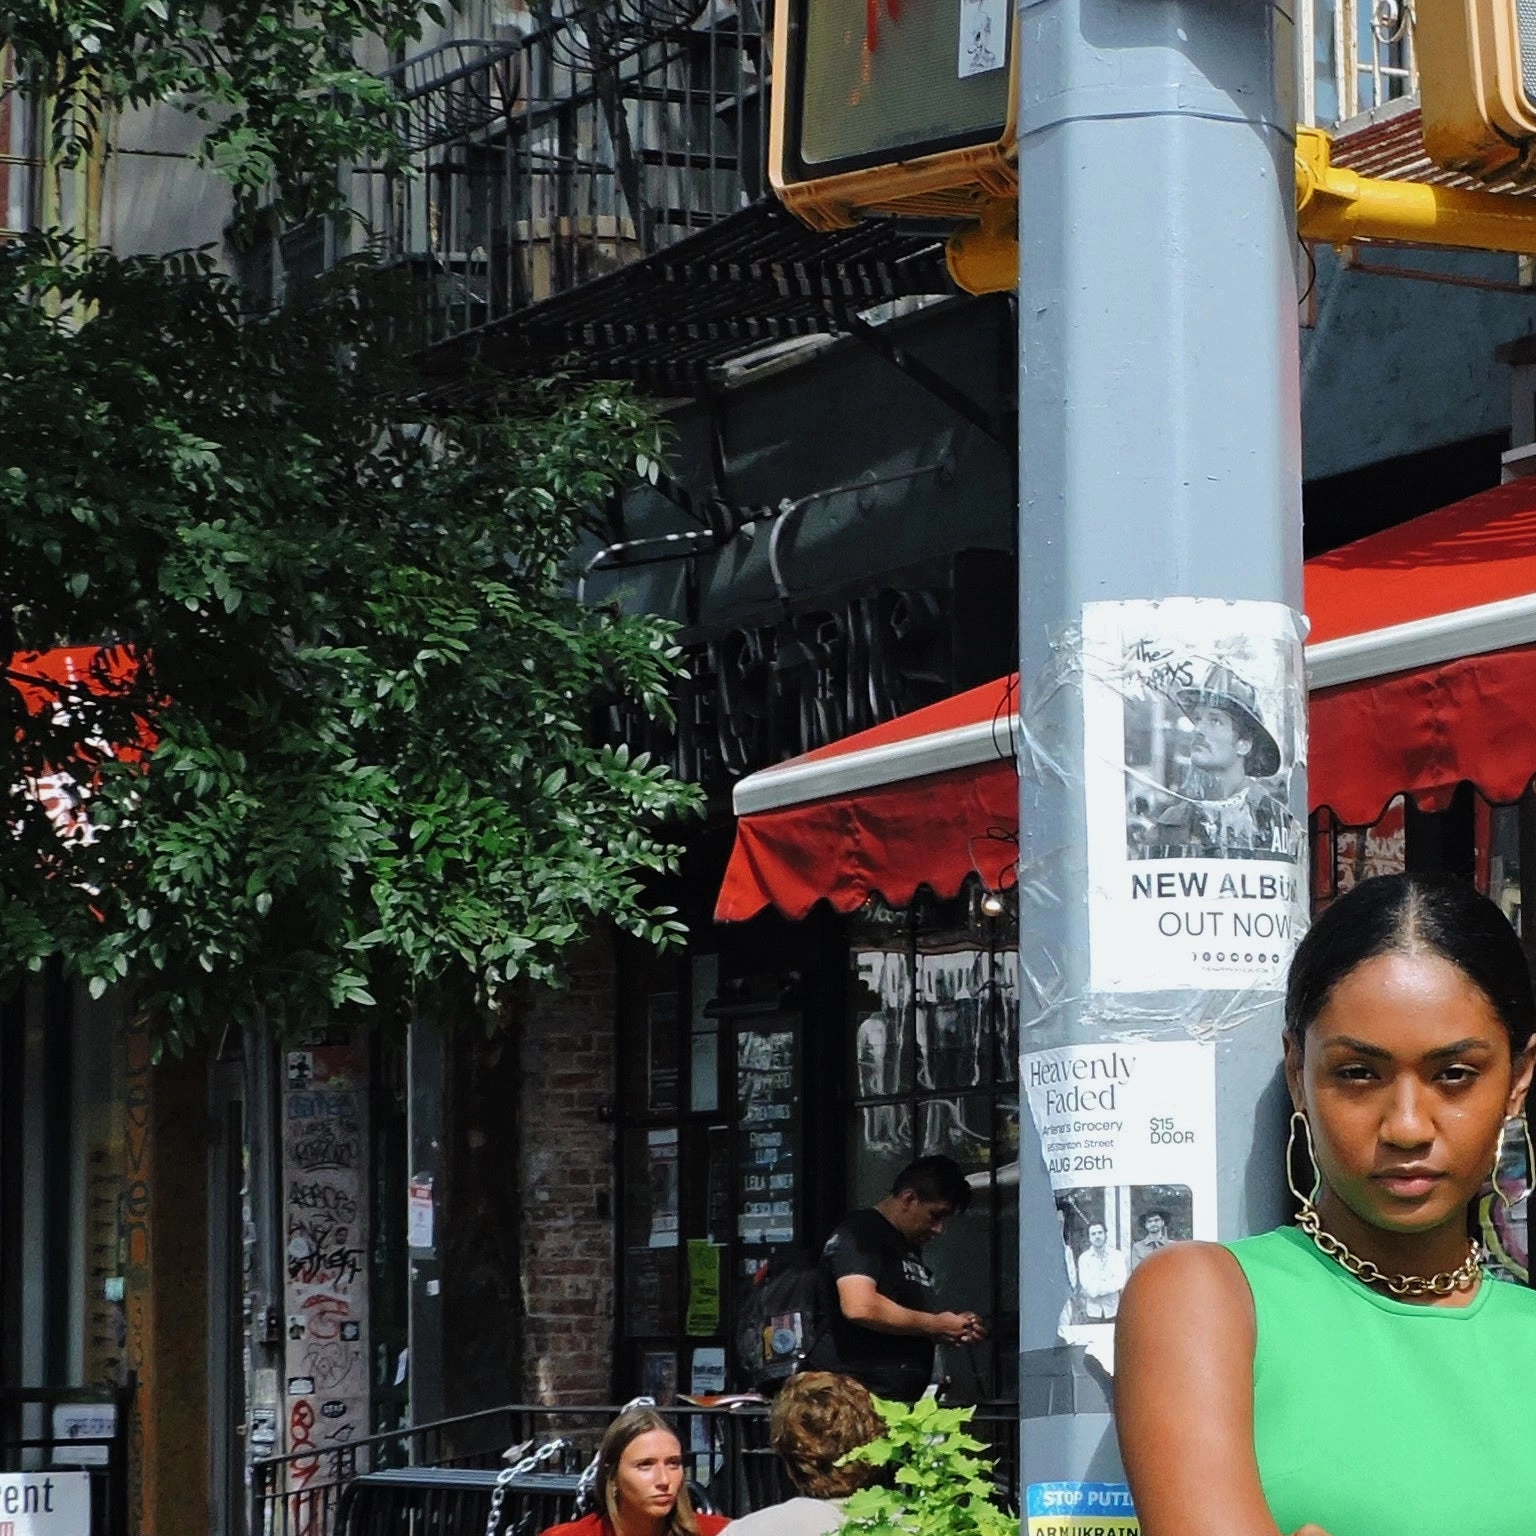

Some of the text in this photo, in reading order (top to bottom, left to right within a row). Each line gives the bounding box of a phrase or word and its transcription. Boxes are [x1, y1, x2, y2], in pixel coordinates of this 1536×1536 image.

[1131, 872, 1208, 900] NEW
[1158, 912, 1292, 939] OUT NOW
[1030, 1052, 1136, 1087] Heavenly
[1046, 1084, 1115, 1115] Faded
[1073, 1121, 1123, 1132] Grocery
[1150, 1117, 1174, 1132] $15
[1084, 1139, 1115, 1149] Street
[1150, 1131, 1195, 1145] DOOR
[1048, 1154, 1113, 1173] AUG 26th
[0, 1477, 54, 1514] ent
[1043, 1490, 1133, 1507] STOP PUTI
